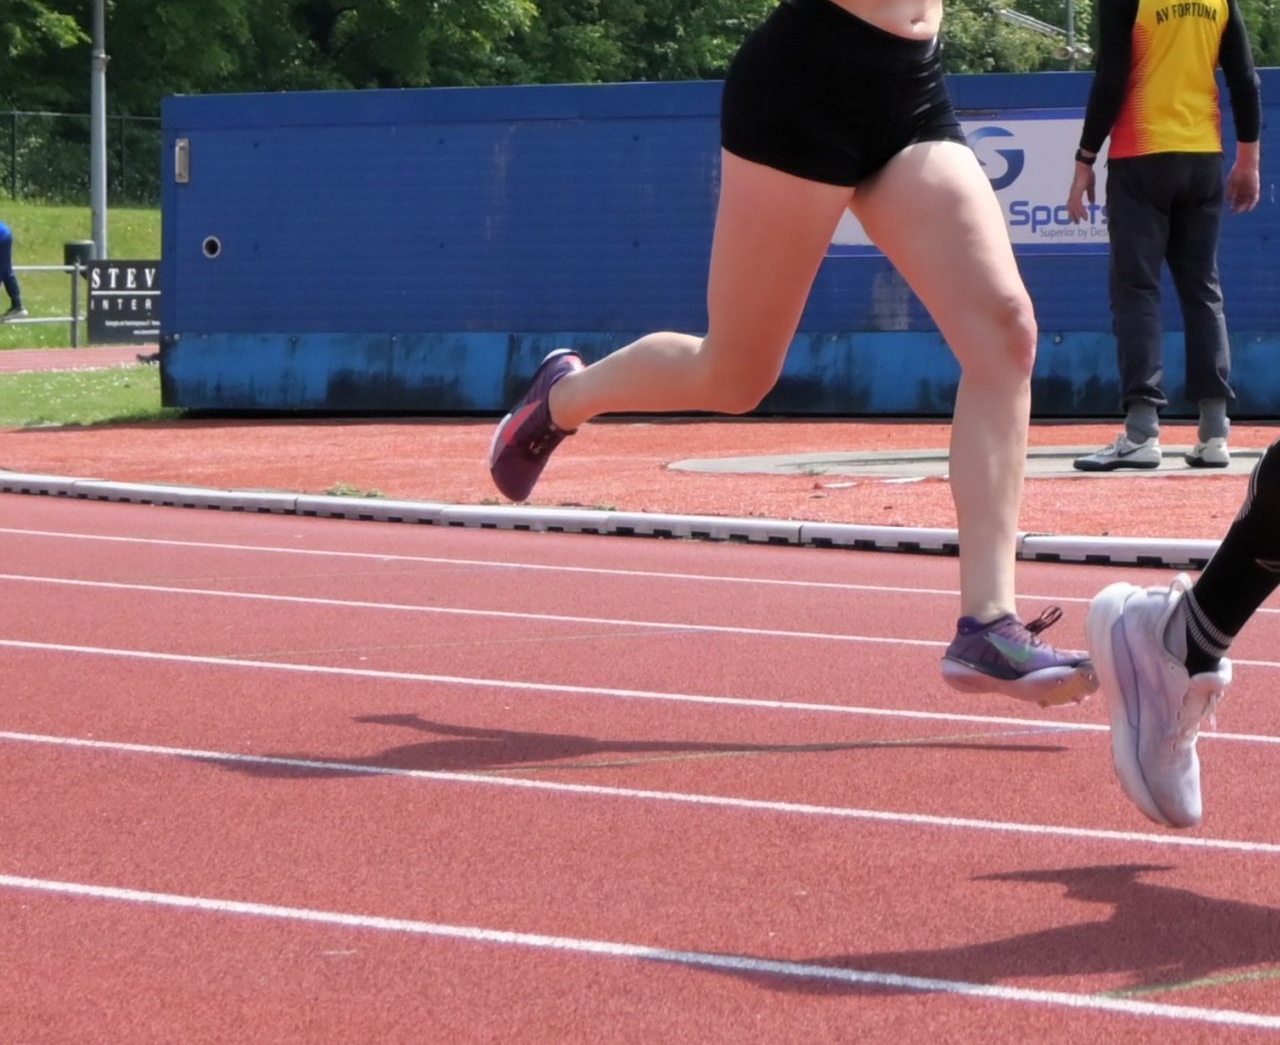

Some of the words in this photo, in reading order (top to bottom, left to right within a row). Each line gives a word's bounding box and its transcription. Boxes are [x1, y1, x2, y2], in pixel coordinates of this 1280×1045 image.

[1155, 6, 1169, 25] AV
[1171, 2, 1217, 22] FORTUNA
[1078, 227, 1088, 239] by
[91, 267, 156, 289] STEV
[91, 298, 152, 310] INTER
